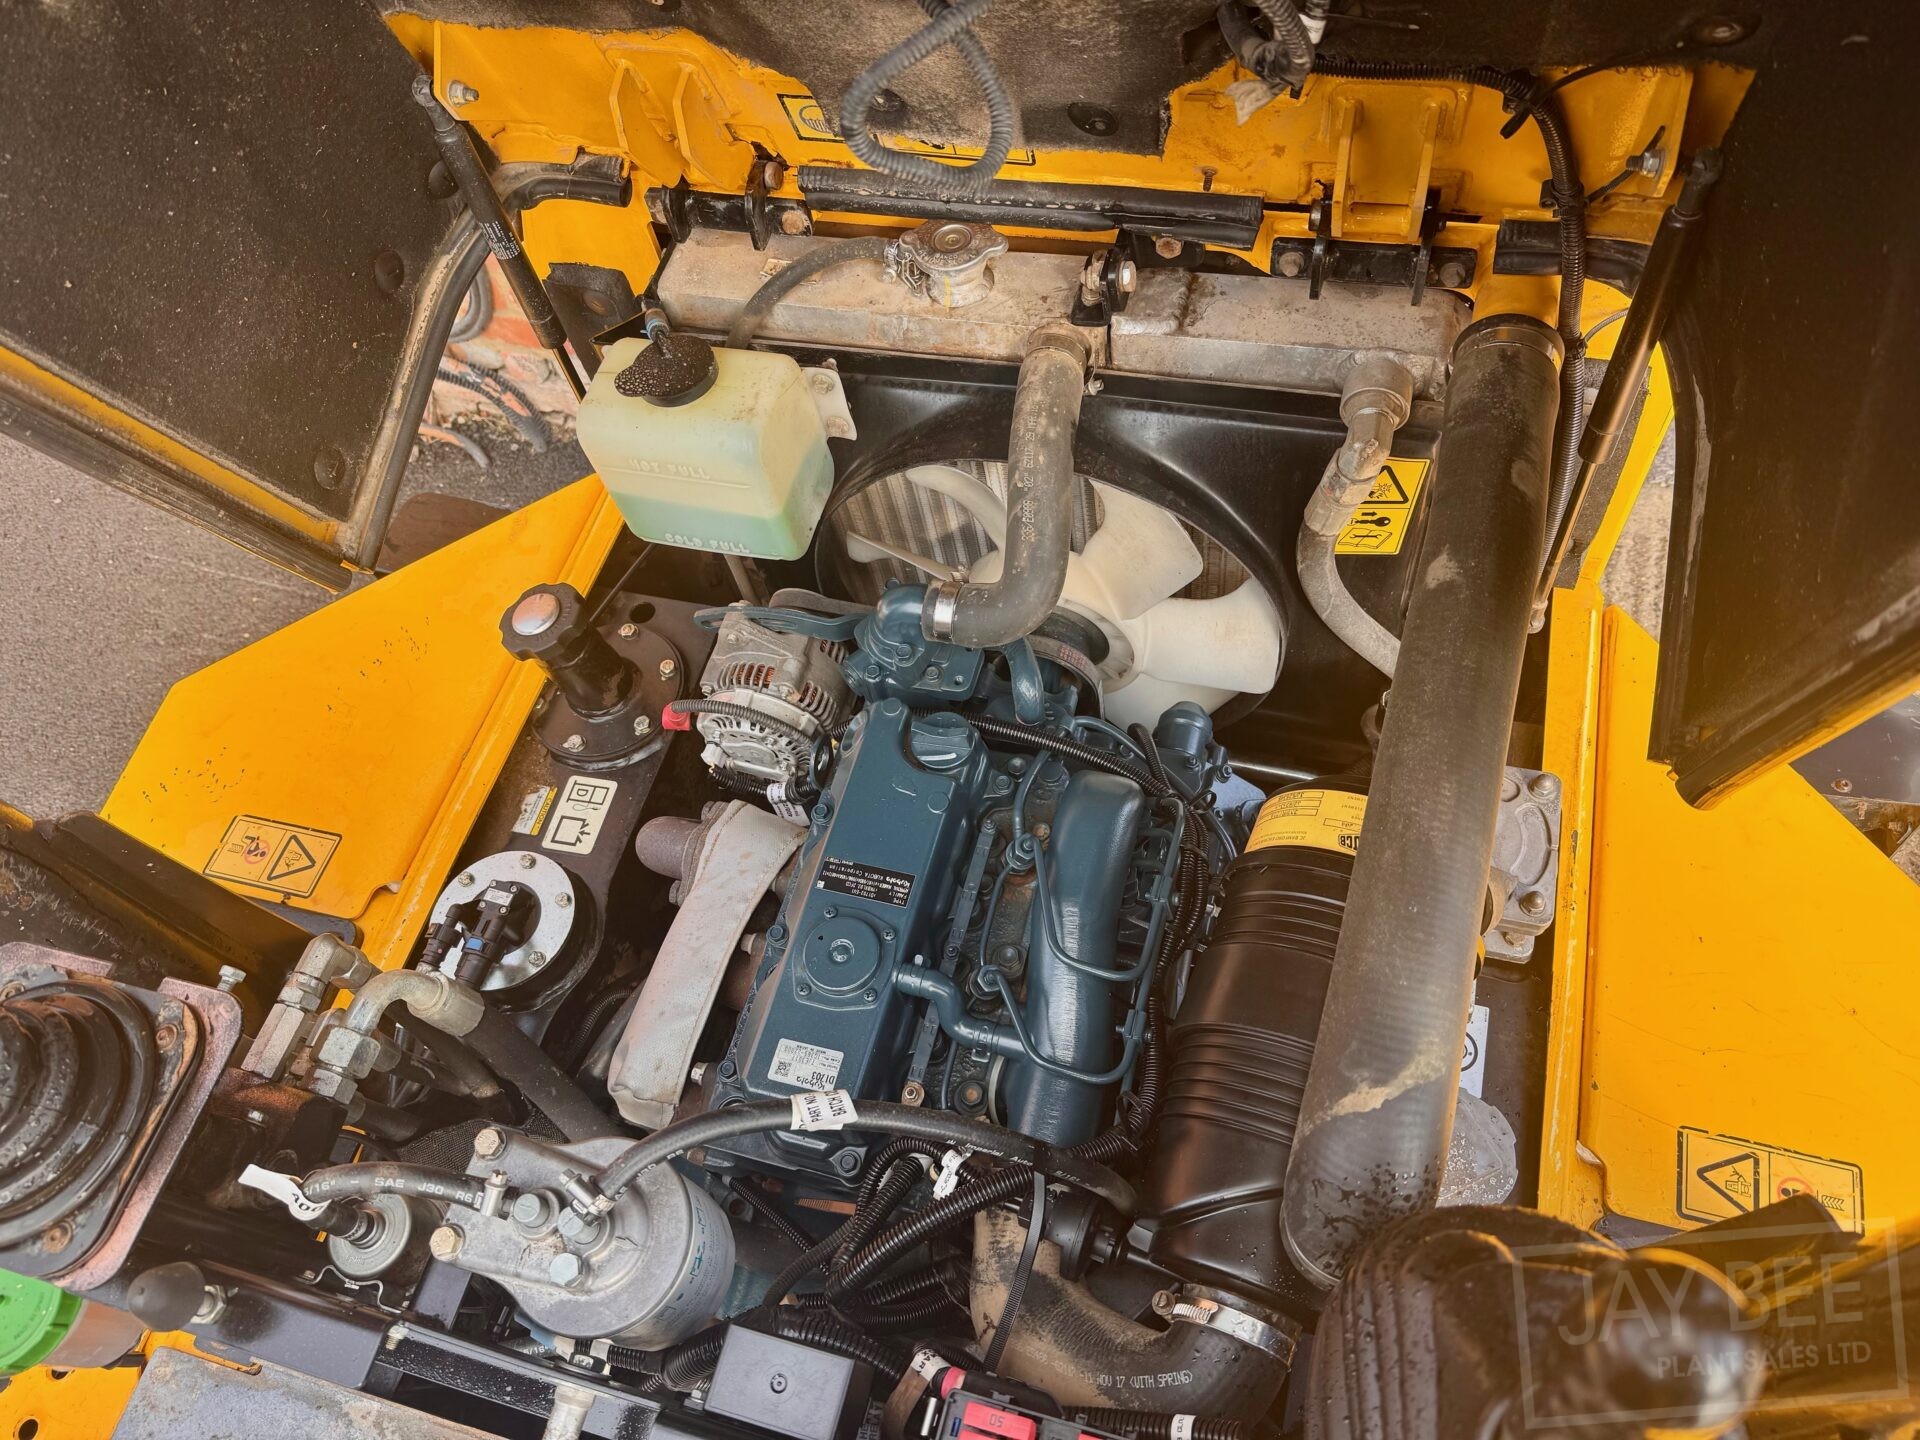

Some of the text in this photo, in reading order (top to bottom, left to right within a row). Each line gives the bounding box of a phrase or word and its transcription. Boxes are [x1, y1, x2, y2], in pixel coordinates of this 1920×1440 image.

[629, 458, 710, 480] HOT FULL
[665, 533, 749, 553] COLD FULL
[536, 796, 551, 825] CAUTION
[1339, 836, 1360, 850] JCB
[828, 863, 862, 876] Corporation
[864, 871, 883, 880] KUBOTA
[885, 875, 910, 887] Kubota
[888, 890, 907, 899] FAMILY
[795, 1075, 825, 1090] Kubota
[810, 1070, 835, 1084] D1703
[826, 1094, 846, 1117] BATCH
[807, 1104, 823, 1123] PART
[964, 1142, 1034, 1166] Imperial Auto
[374, 1177, 405, 1188] SAE
[417, 1182, 444, 1195] J30
[455, 1191, 473, 1202] R6
[1116, 1375, 1125, 1386] 17
